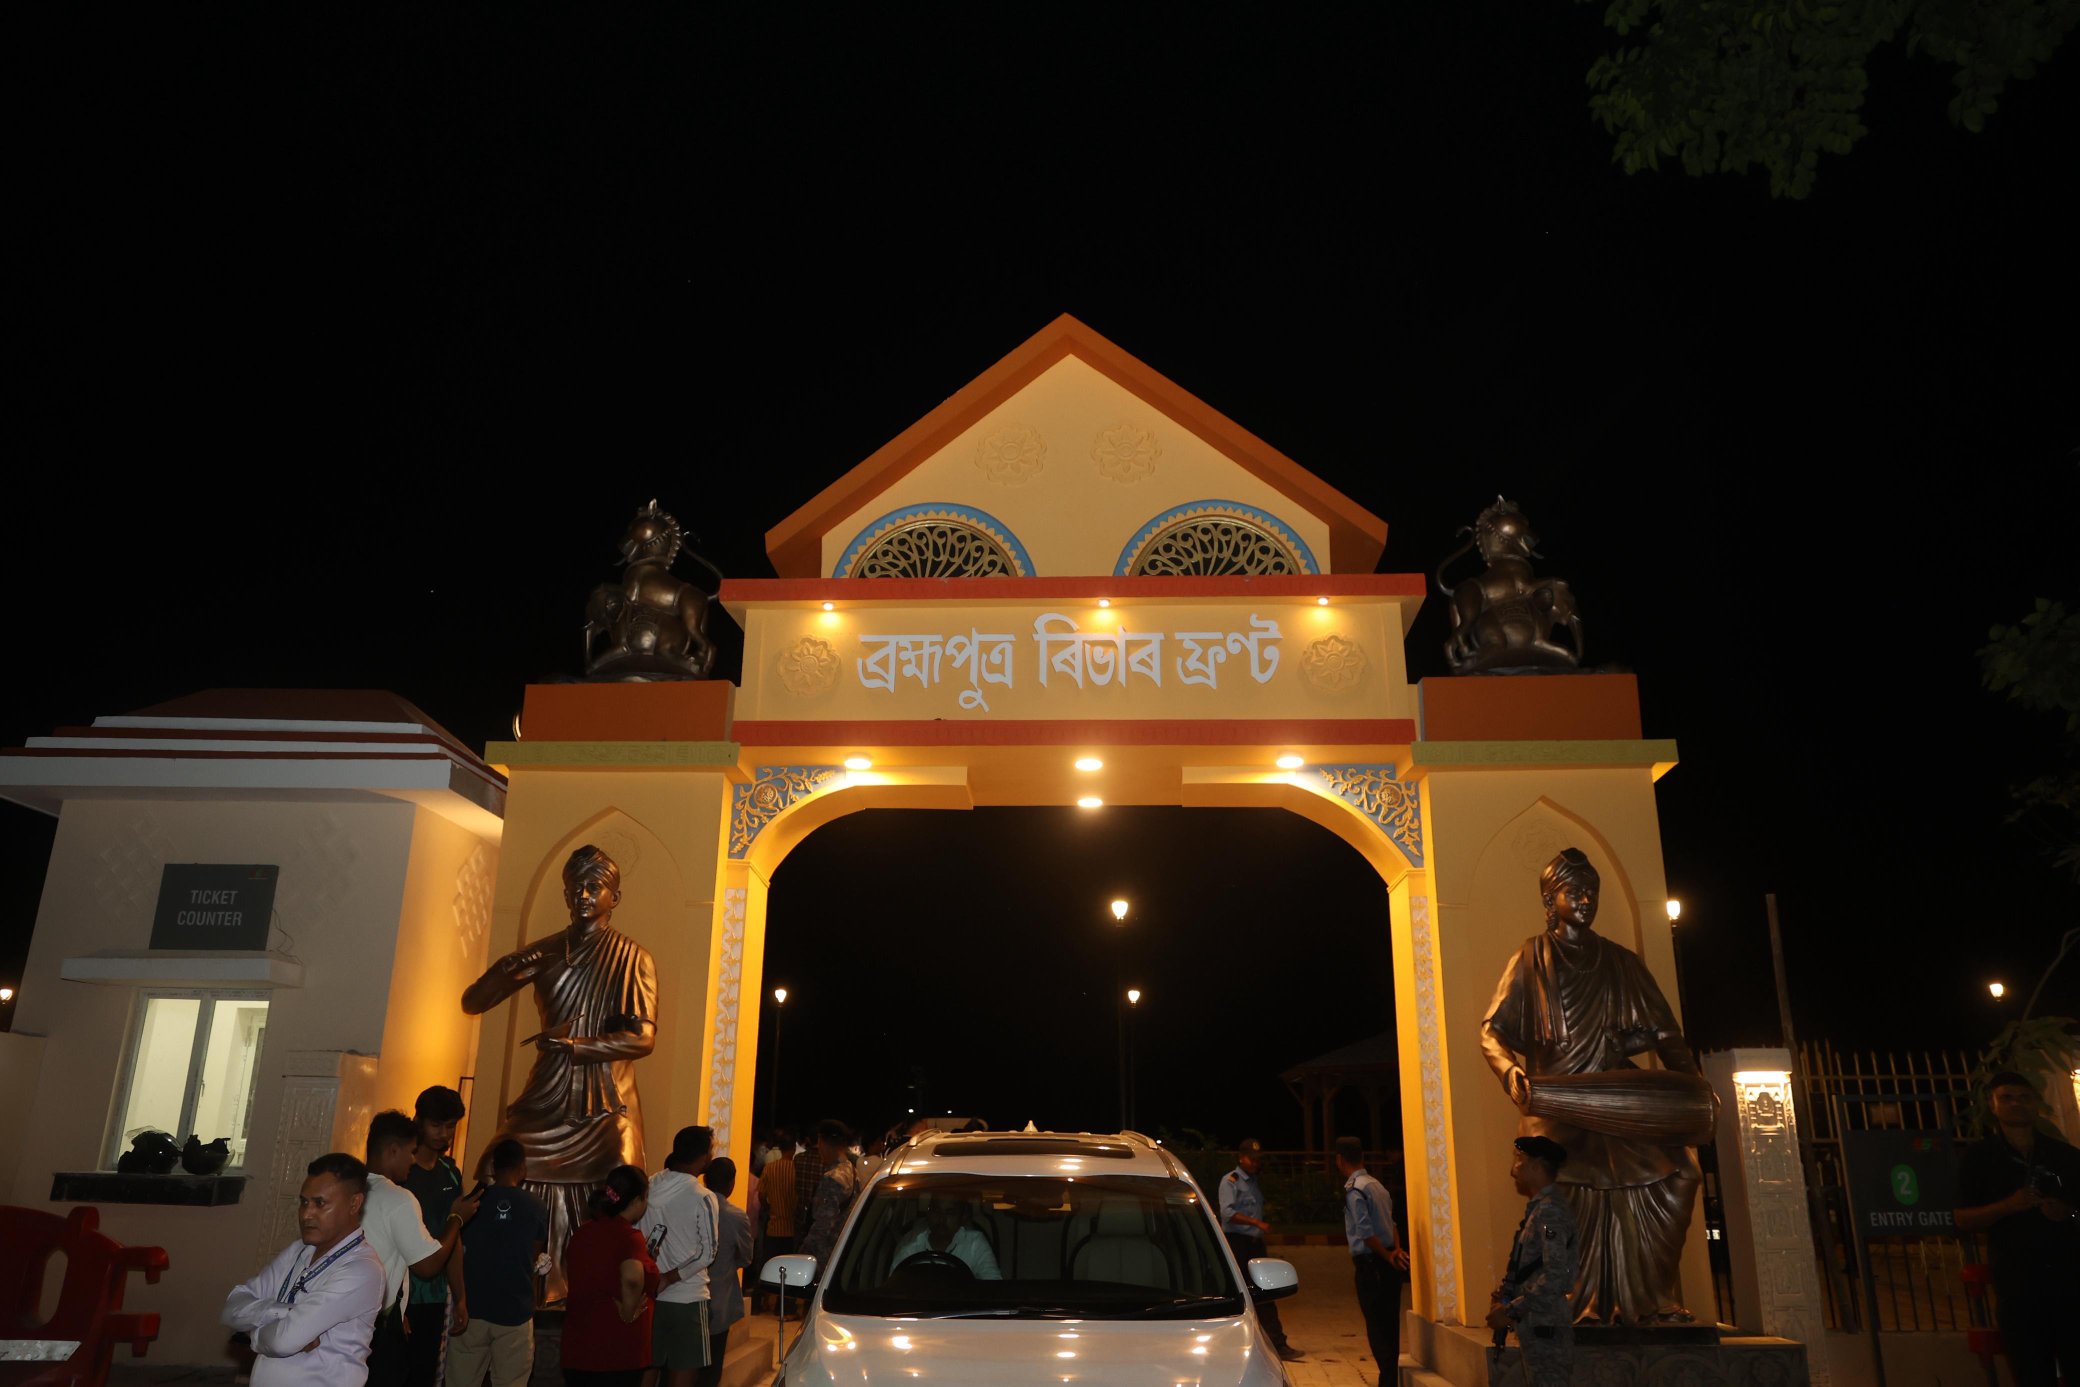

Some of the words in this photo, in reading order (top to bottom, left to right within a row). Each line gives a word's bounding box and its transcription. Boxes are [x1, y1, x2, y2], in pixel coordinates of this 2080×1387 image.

[1032, 612, 1165, 689] ৰিভাৰ
[190, 890, 238, 905] TICKET
[177, 911, 243, 926] COUNTER
[1897, 1171, 1912, 1195] 2
[1870, 1212, 1914, 1227] ENTRY
[1918, 1211, 1953, 1226] GATE
